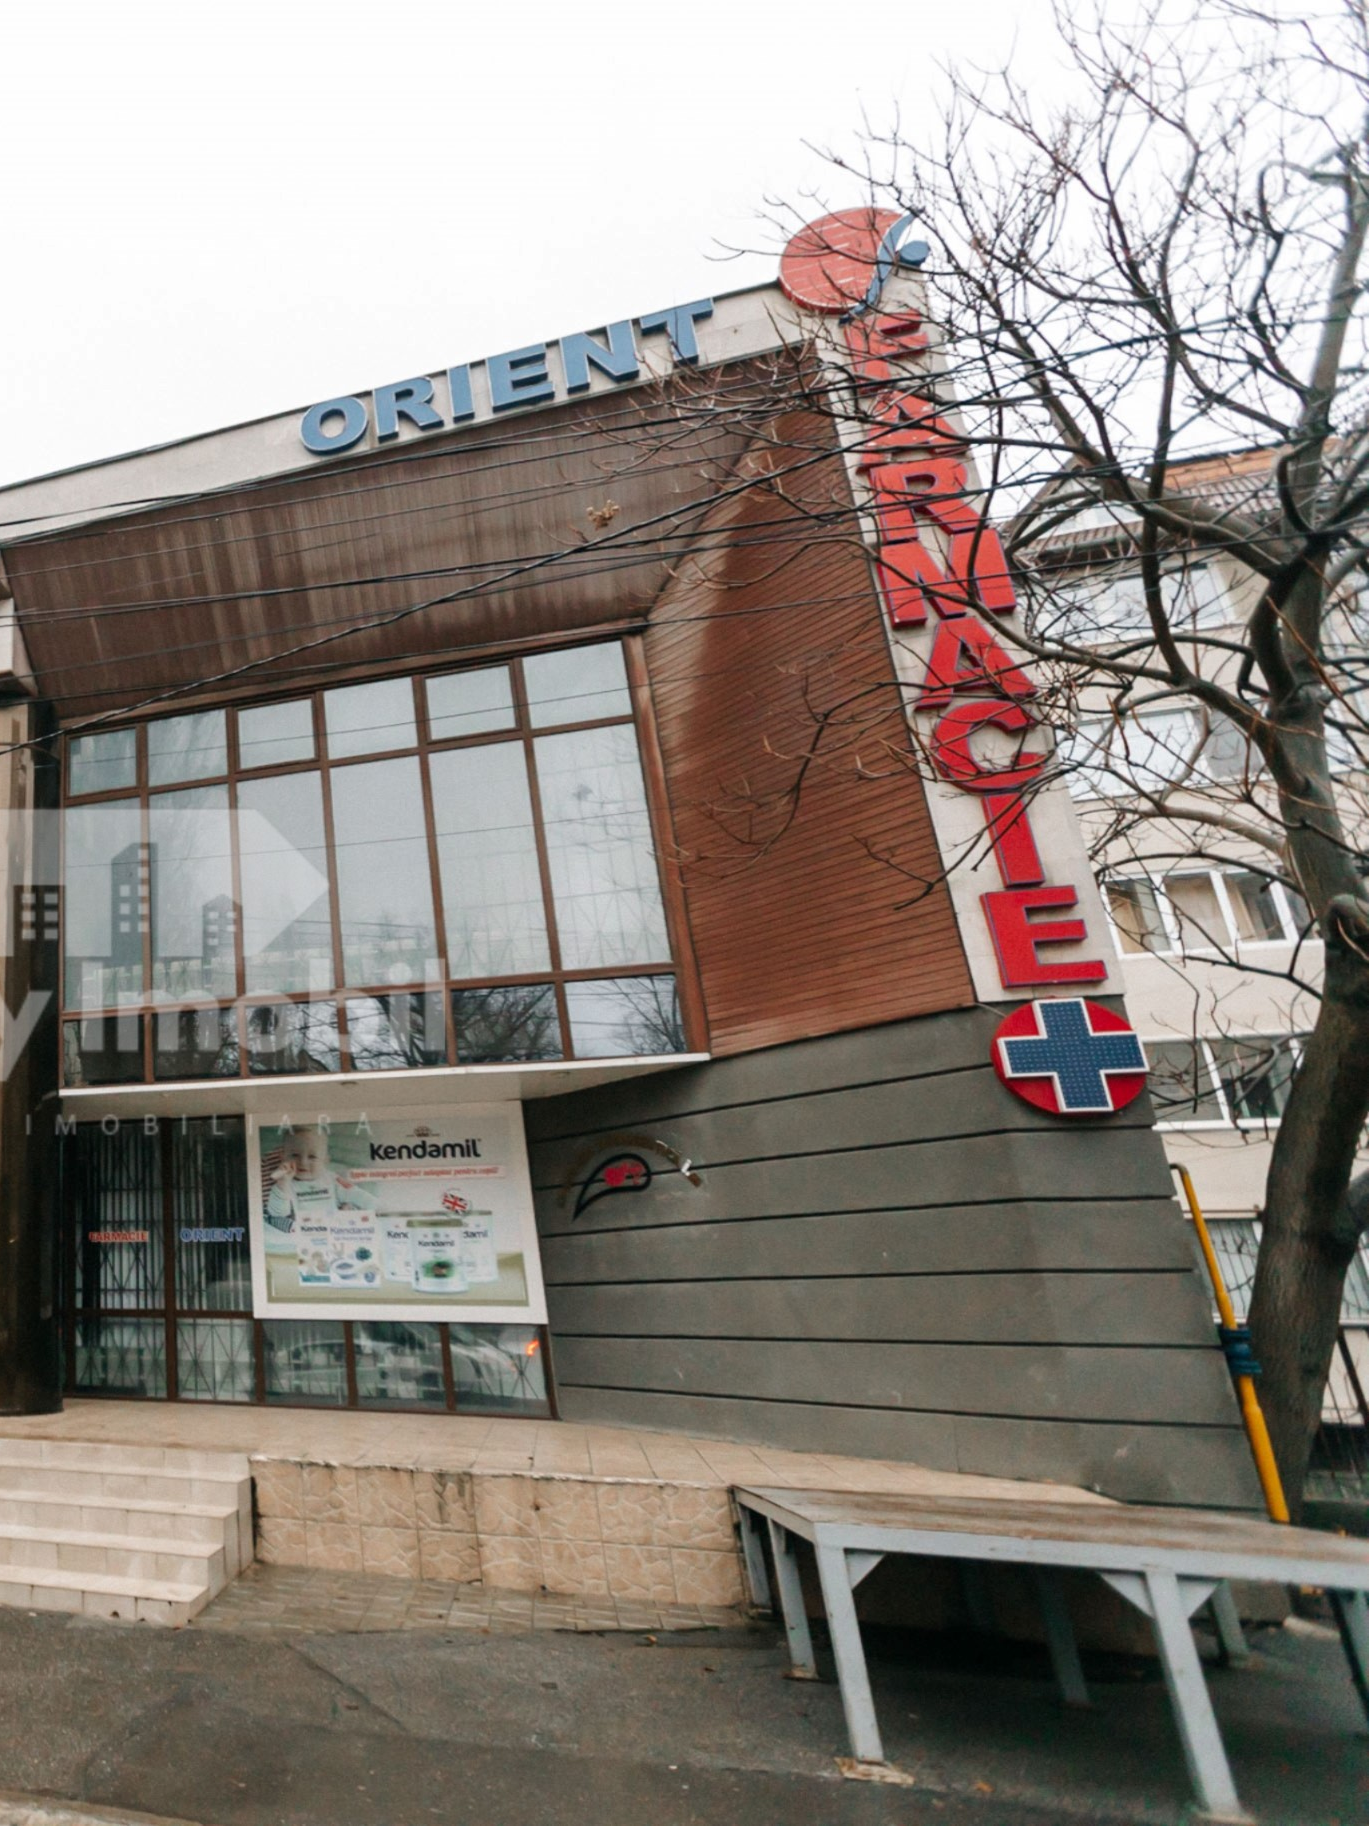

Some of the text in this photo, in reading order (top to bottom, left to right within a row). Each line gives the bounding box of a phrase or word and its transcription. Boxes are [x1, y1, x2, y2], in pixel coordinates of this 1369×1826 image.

[299, 298, 714, 456] ORIENT
[842, 309, 1108, 990] FARMACIE
[89, 1230, 150, 1243] FARMACIE
[180, 1226, 245, 1243] ORIENT
